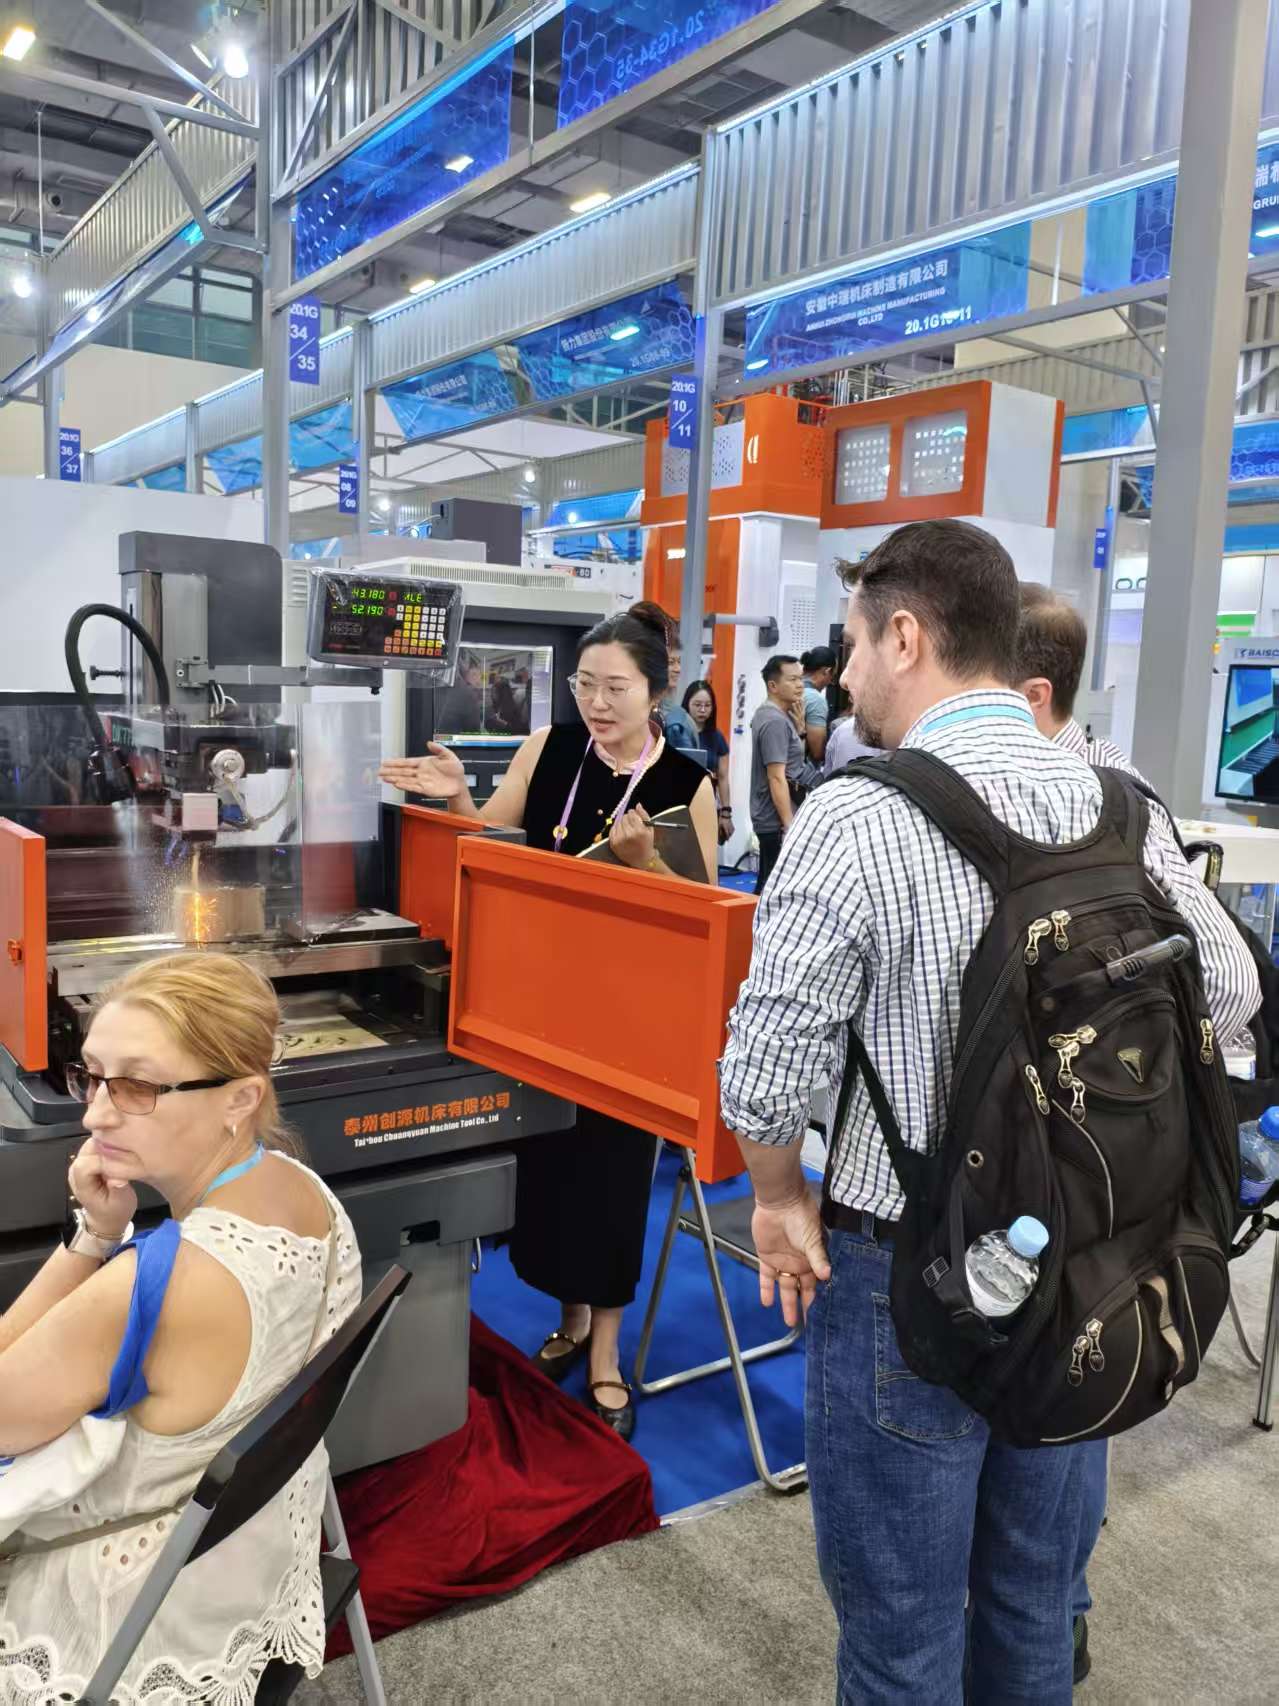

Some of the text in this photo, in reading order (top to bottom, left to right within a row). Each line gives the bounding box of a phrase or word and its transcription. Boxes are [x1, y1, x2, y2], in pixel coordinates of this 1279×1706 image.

[290, 324, 308, 340] 34
[297, 355, 316, 370] 35
[673, 400, 687, 411] 10
[678, 424, 691, 436] 11
[61, 446, 73, 456] 36
[67, 464, 78, 474] 37
[344, 1091, 510, 1137] 泰州创源机床有限公司
[430, 1121, 459, 1133] Machine
[461, 1118, 475, 1128] Tool
